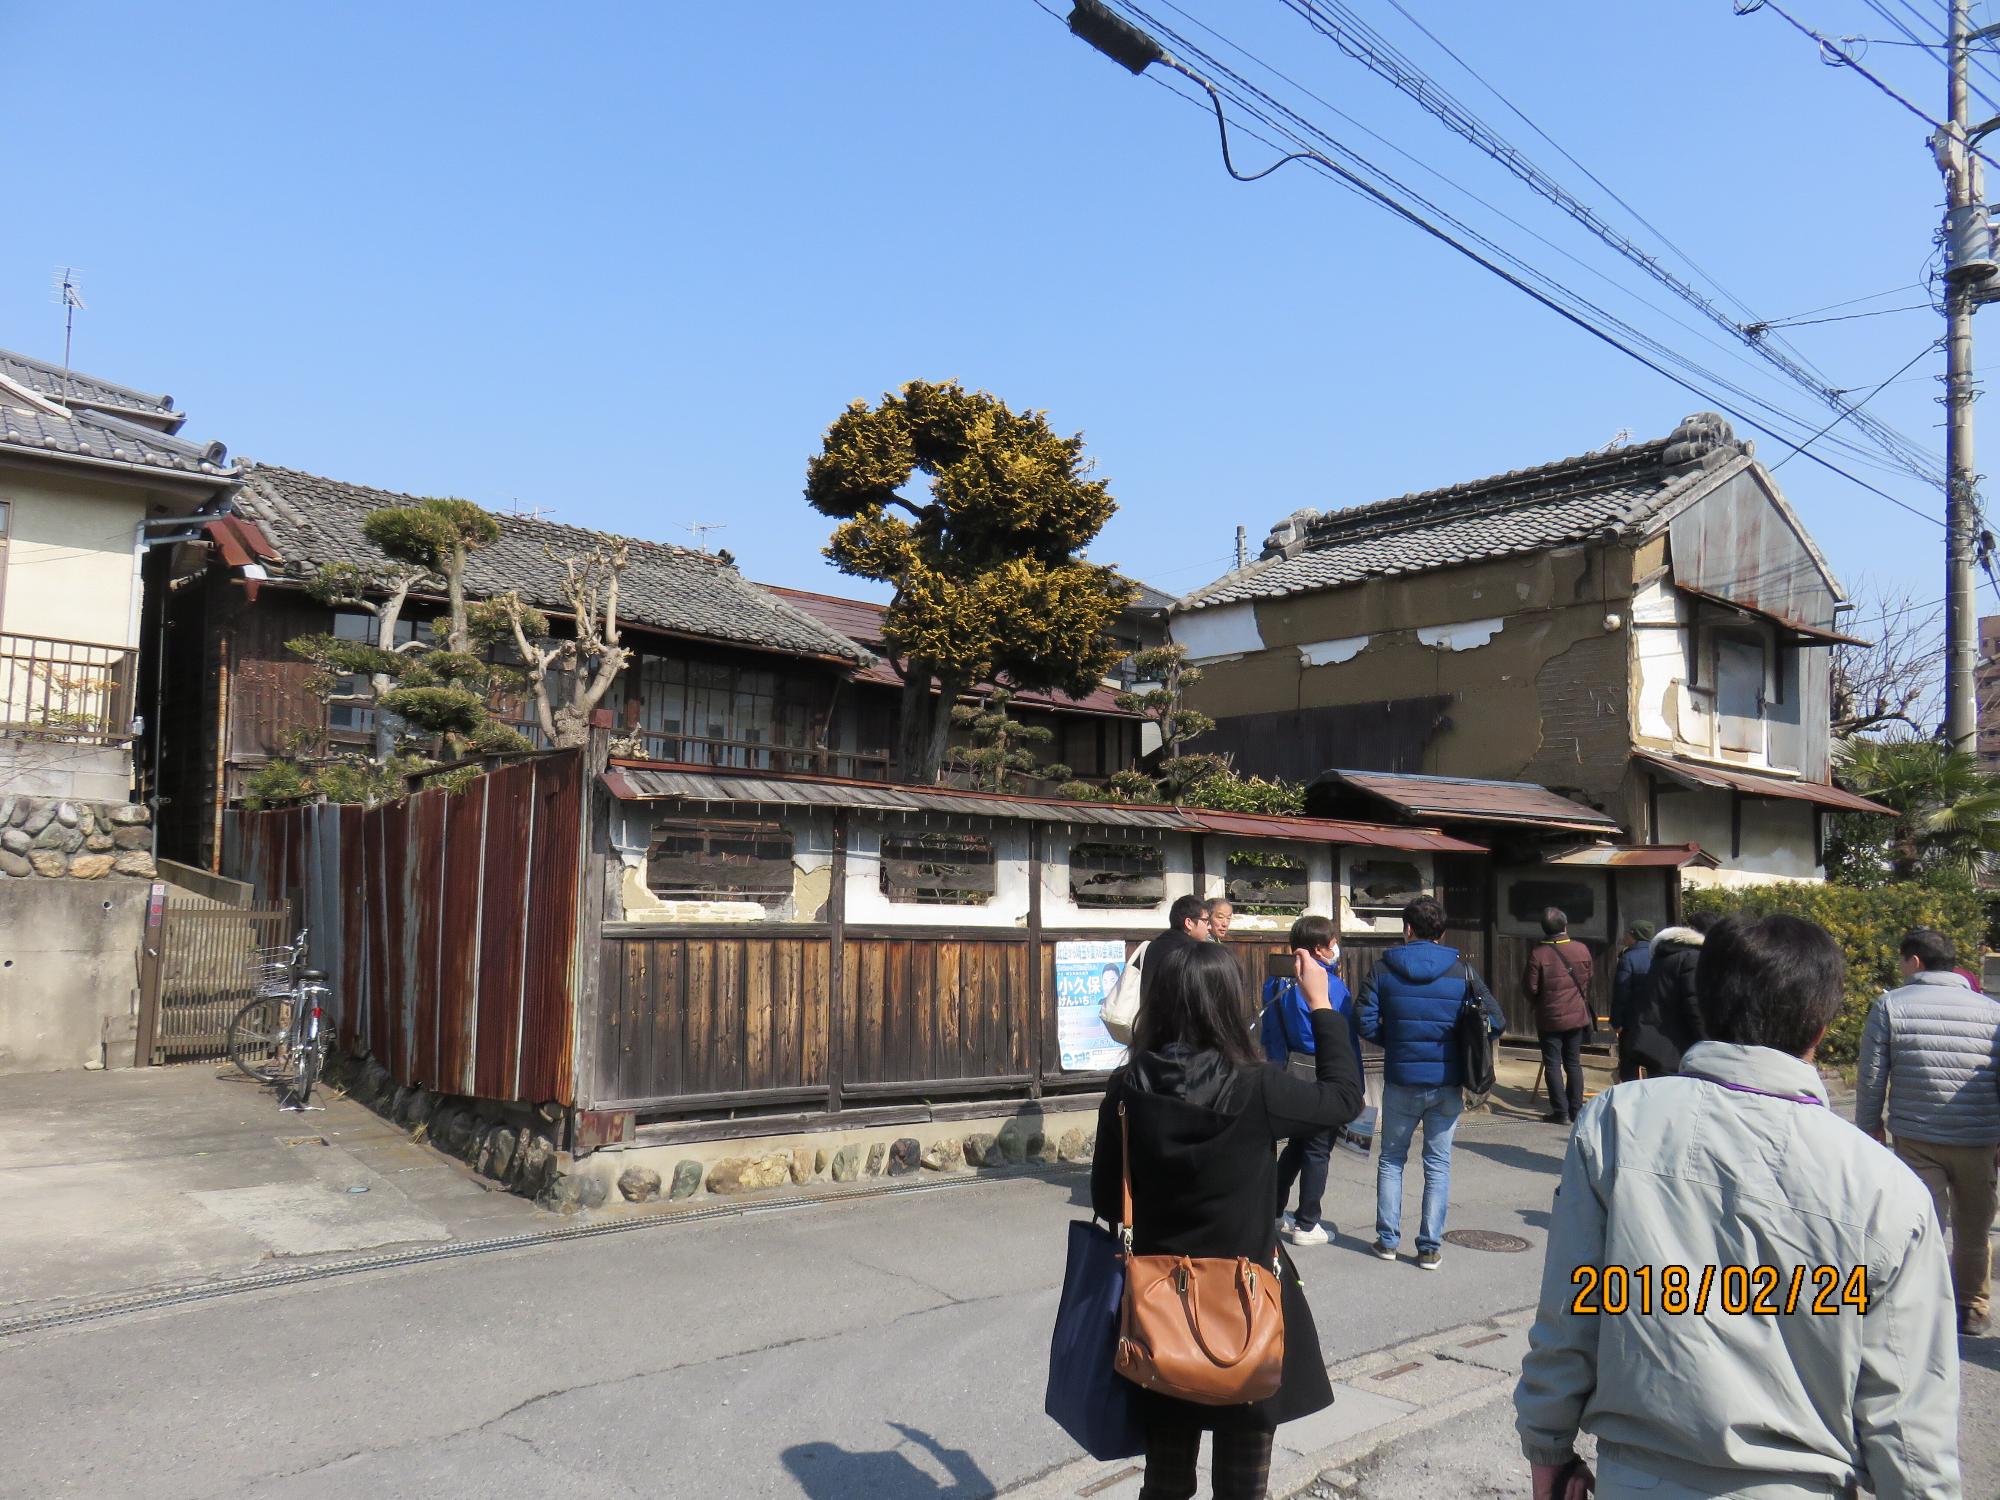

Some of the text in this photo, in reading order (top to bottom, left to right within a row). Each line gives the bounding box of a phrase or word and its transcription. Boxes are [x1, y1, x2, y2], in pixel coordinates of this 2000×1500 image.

[1058, 975, 1101, 995] 小久保
[1058, 995, 1090, 1007] けんいち
